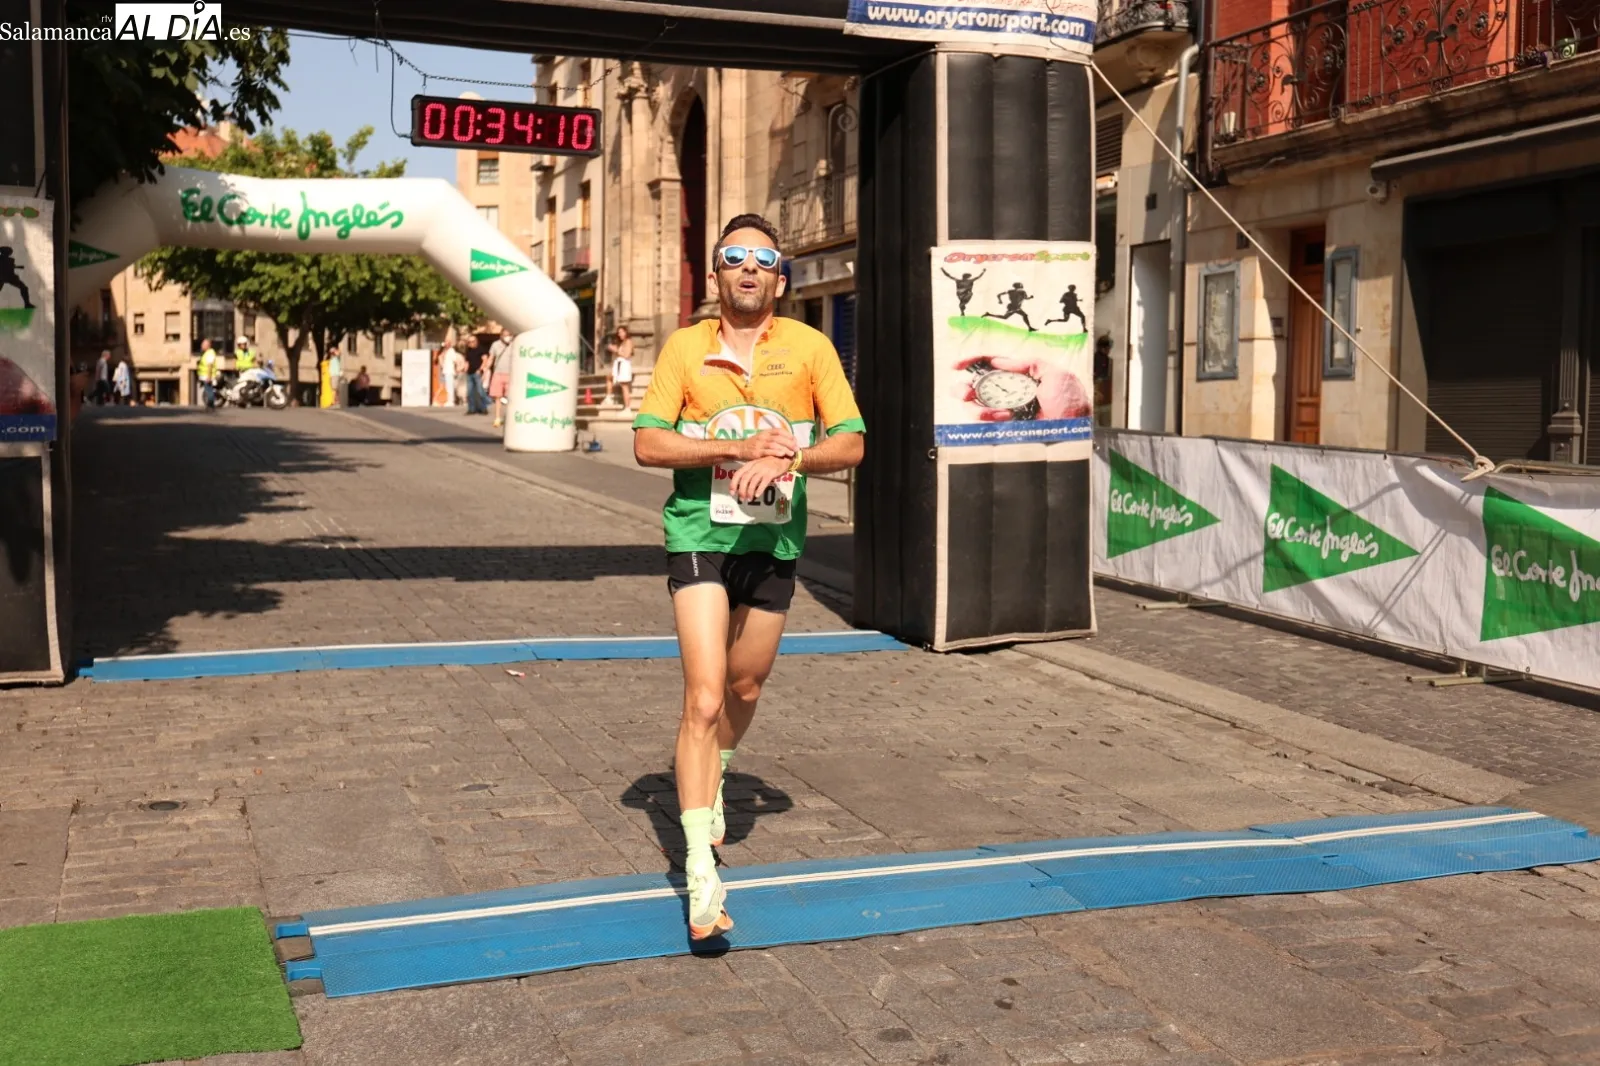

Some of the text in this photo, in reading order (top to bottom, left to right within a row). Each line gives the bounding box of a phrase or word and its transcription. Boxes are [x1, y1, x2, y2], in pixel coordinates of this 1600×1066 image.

[867, 5, 1086, 37] www.orycronsport.com
[424, 103, 594, 150] 00:34:10
[180, 187, 215, 223] El
[297, 190, 404, 241] Inglés
[1110, 488, 1194, 531] El Corte Inglés
[1267, 512, 1379, 563] El Corte Inglés
[1491, 544, 1513, 577] El
[1512, 550, 1567, 588] Corte
